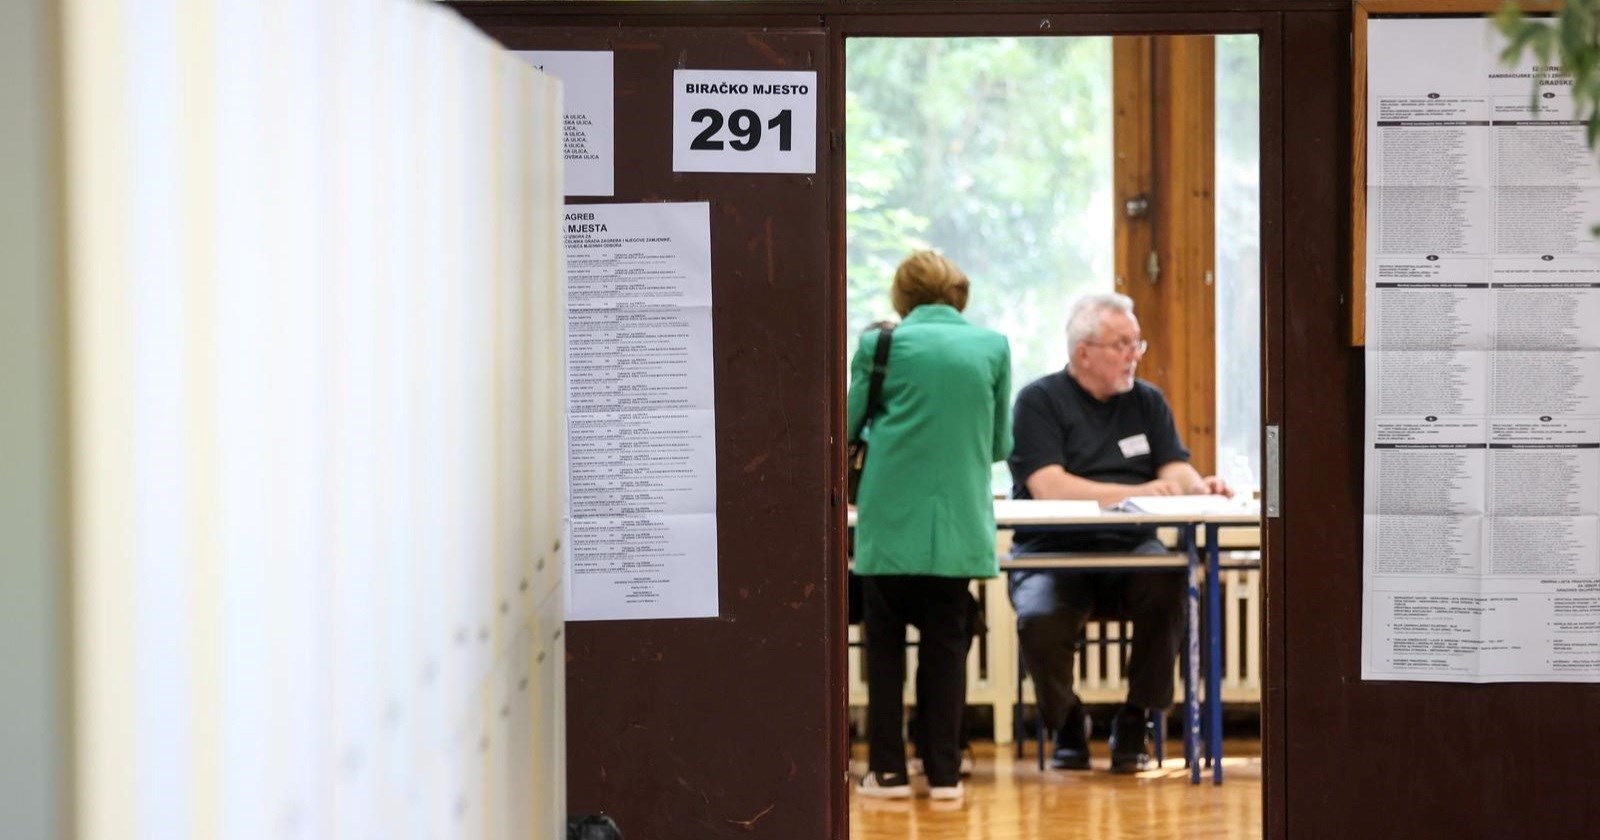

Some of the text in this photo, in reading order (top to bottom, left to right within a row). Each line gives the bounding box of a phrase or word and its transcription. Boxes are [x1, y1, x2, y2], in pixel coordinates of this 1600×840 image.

[686, 82, 809, 95] BIRAČKO MJESTO
[689, 108, 792, 152] 291
[568, 224, 608, 233] MJESTA
